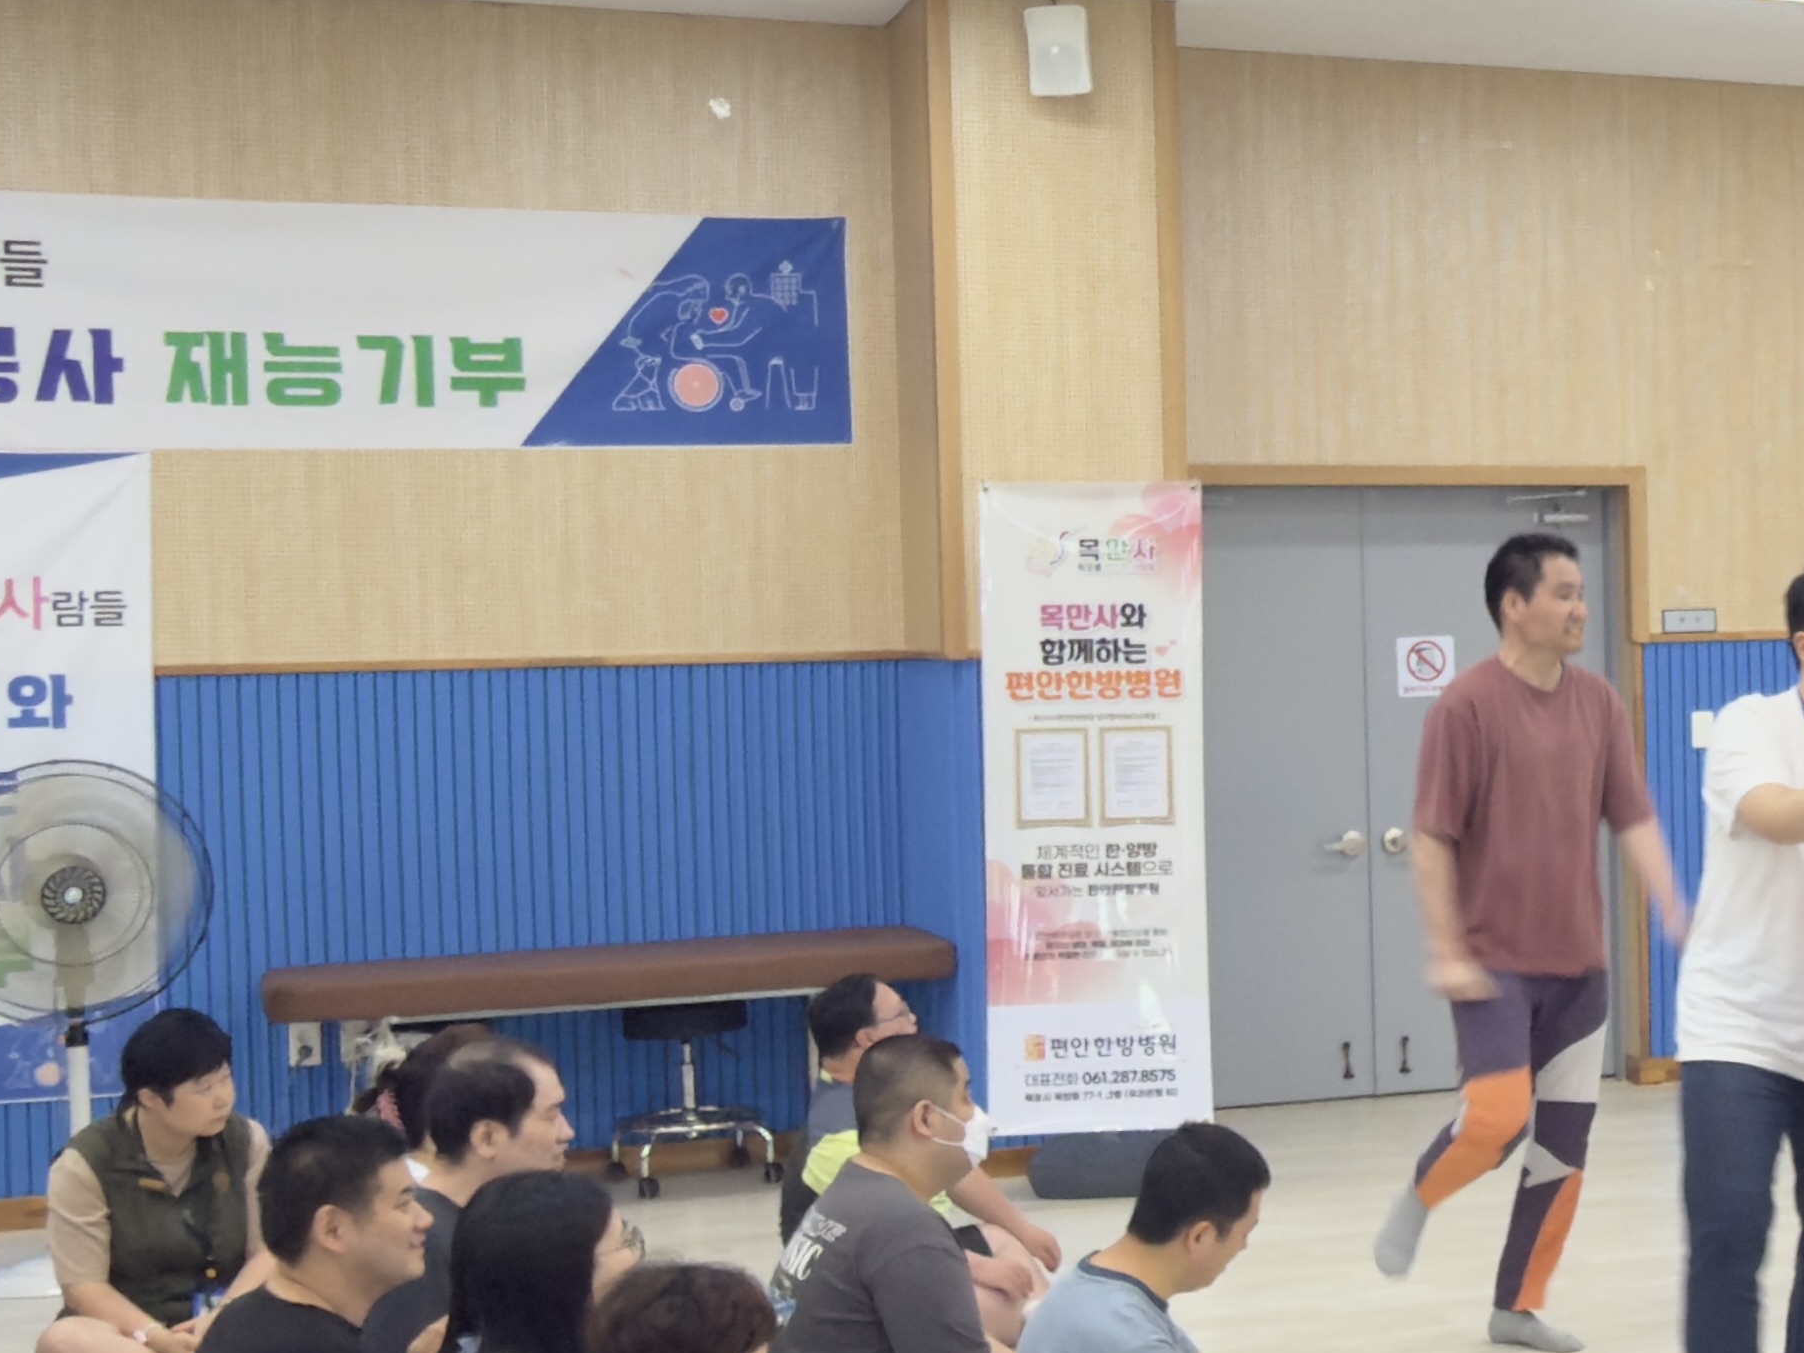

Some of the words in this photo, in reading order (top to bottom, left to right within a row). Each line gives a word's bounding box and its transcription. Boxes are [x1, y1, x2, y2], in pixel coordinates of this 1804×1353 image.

[162, 331, 527, 410] 재능기부
[1040, 602, 1147, 631] 목만사와
[1039, 637, 1147, 666] 함께하는
[1005, 668, 1182, 702] 편안한방병원
[1057, 862, 1089, 879] 진료
[1093, 860, 1173, 877] 시스템으로
[1051, 1034, 1177, 1060] 편안한방병원
